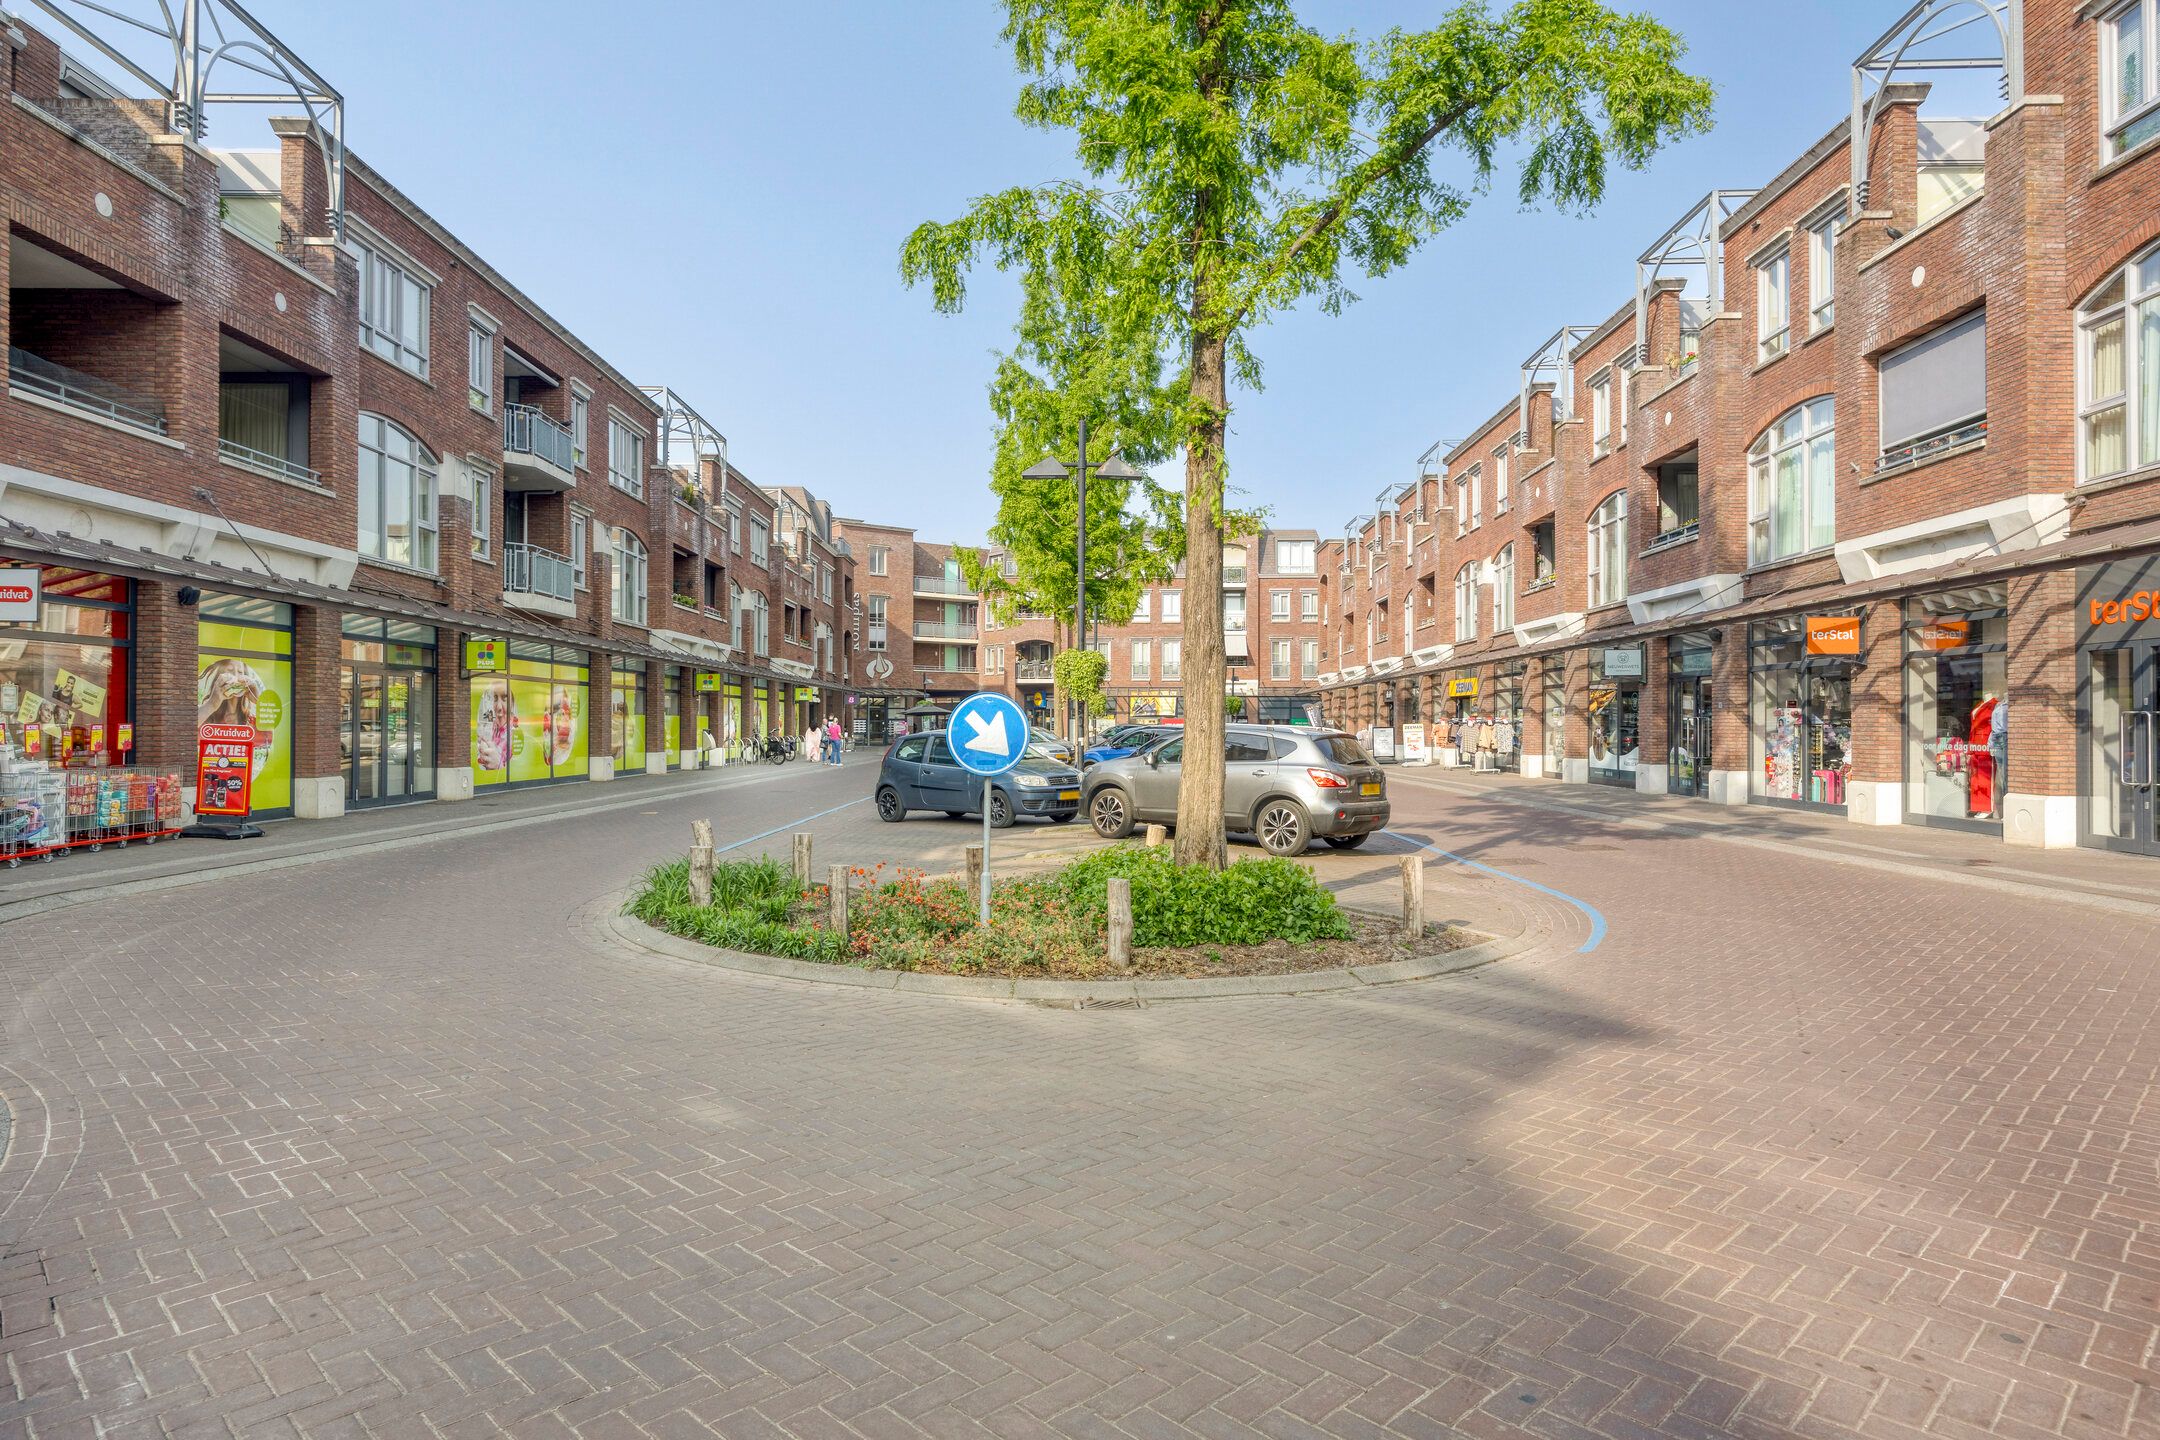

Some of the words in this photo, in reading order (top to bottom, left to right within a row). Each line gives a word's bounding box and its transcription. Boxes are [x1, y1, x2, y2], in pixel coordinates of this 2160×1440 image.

[1812, 629, 1855, 640] terStal
[1456, 681, 1473, 693] ZEEMAN
[214, 727, 250, 738] Kruidvat
[205, 744, 246, 756] ACTIE!
[1953, 741, 1968, 753] dag
